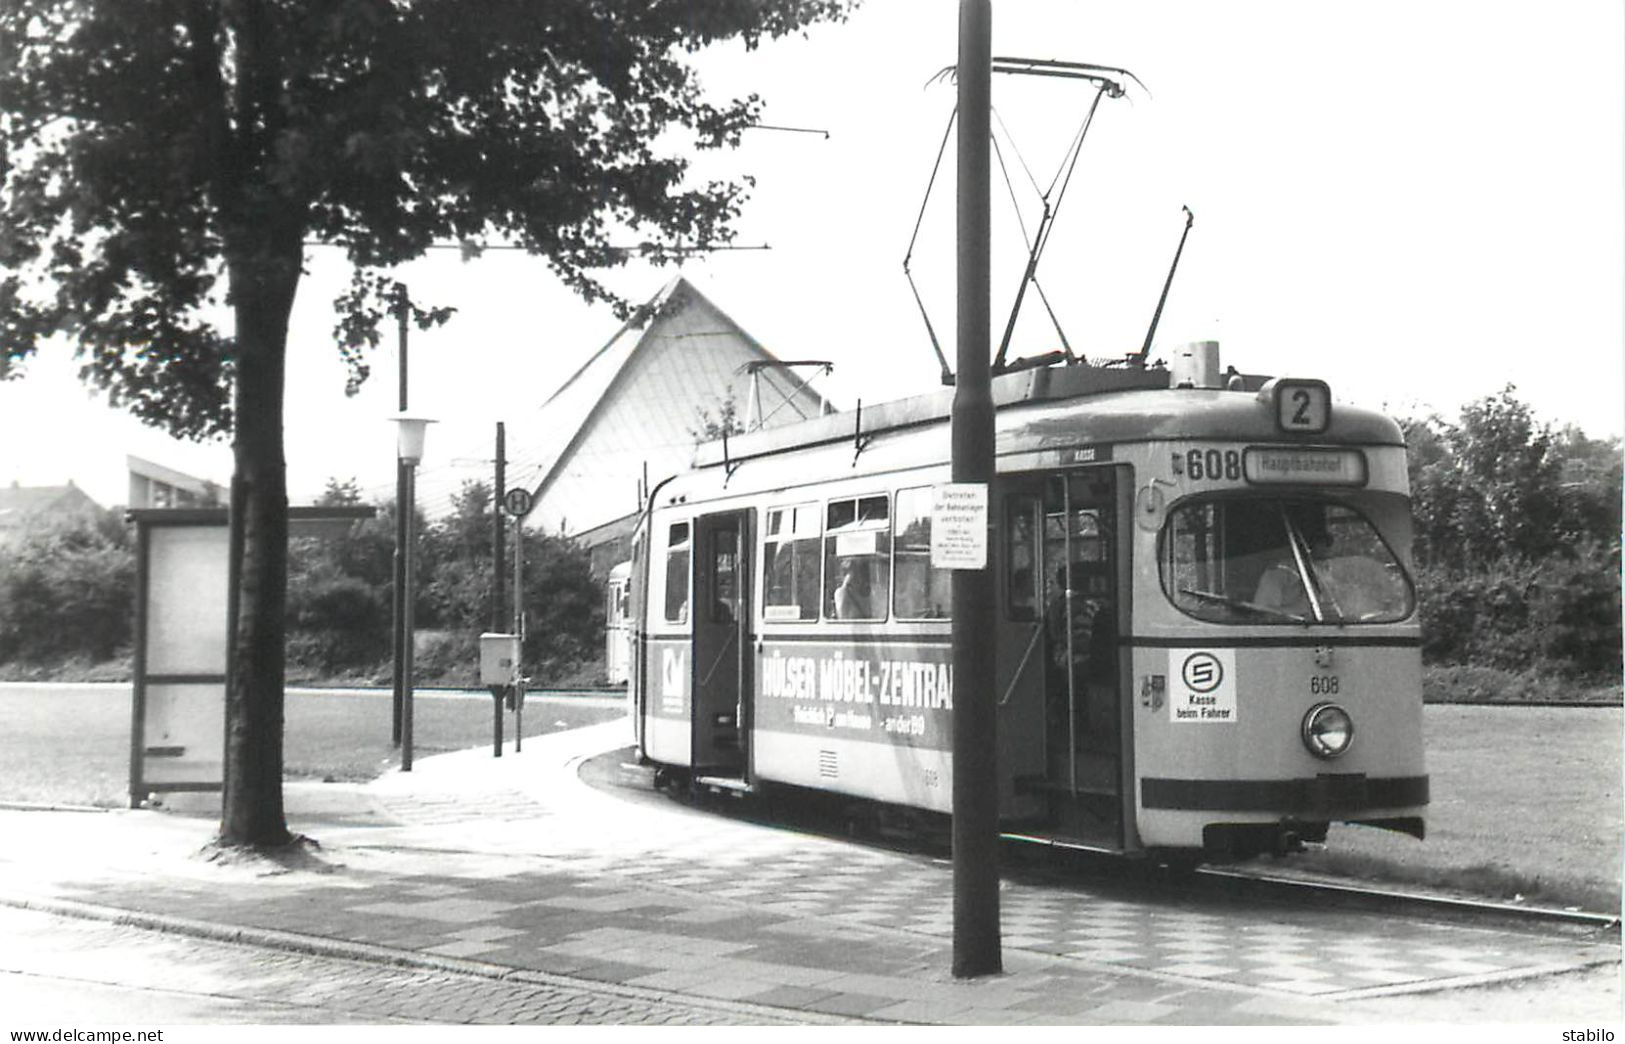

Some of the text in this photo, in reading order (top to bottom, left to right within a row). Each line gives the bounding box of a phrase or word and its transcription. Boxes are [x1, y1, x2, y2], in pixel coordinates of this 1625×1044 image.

[1291, 391, 1310, 425] 2
[1186, 448, 1240, 481] 608
[511, 494, 525, 511] H
[762, 649, 816, 699] HÜLSER
[1311, 676, 1339, 694] 608
[1189, 694, 1217, 706] Kasse
[1177, 707, 1230, 720] beim Fahrer
